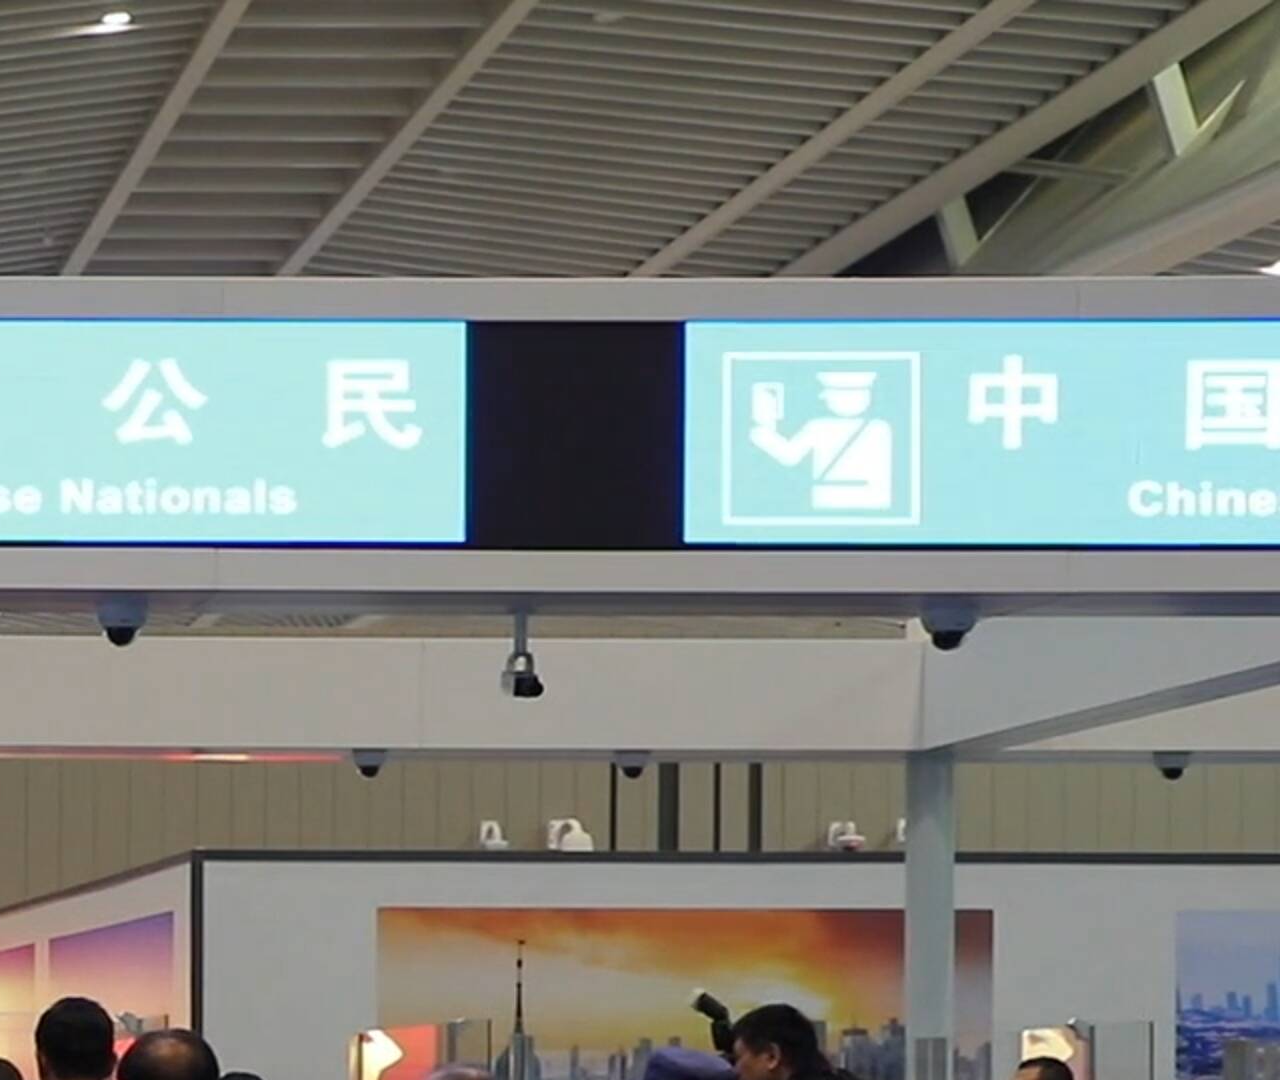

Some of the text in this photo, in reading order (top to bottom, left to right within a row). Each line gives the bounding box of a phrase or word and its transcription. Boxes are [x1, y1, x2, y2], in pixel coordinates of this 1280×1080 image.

[967, 354, 1280, 451] 中国
[60, 478, 298, 515] Nationals
[1127, 479, 1278, 517] Chine
